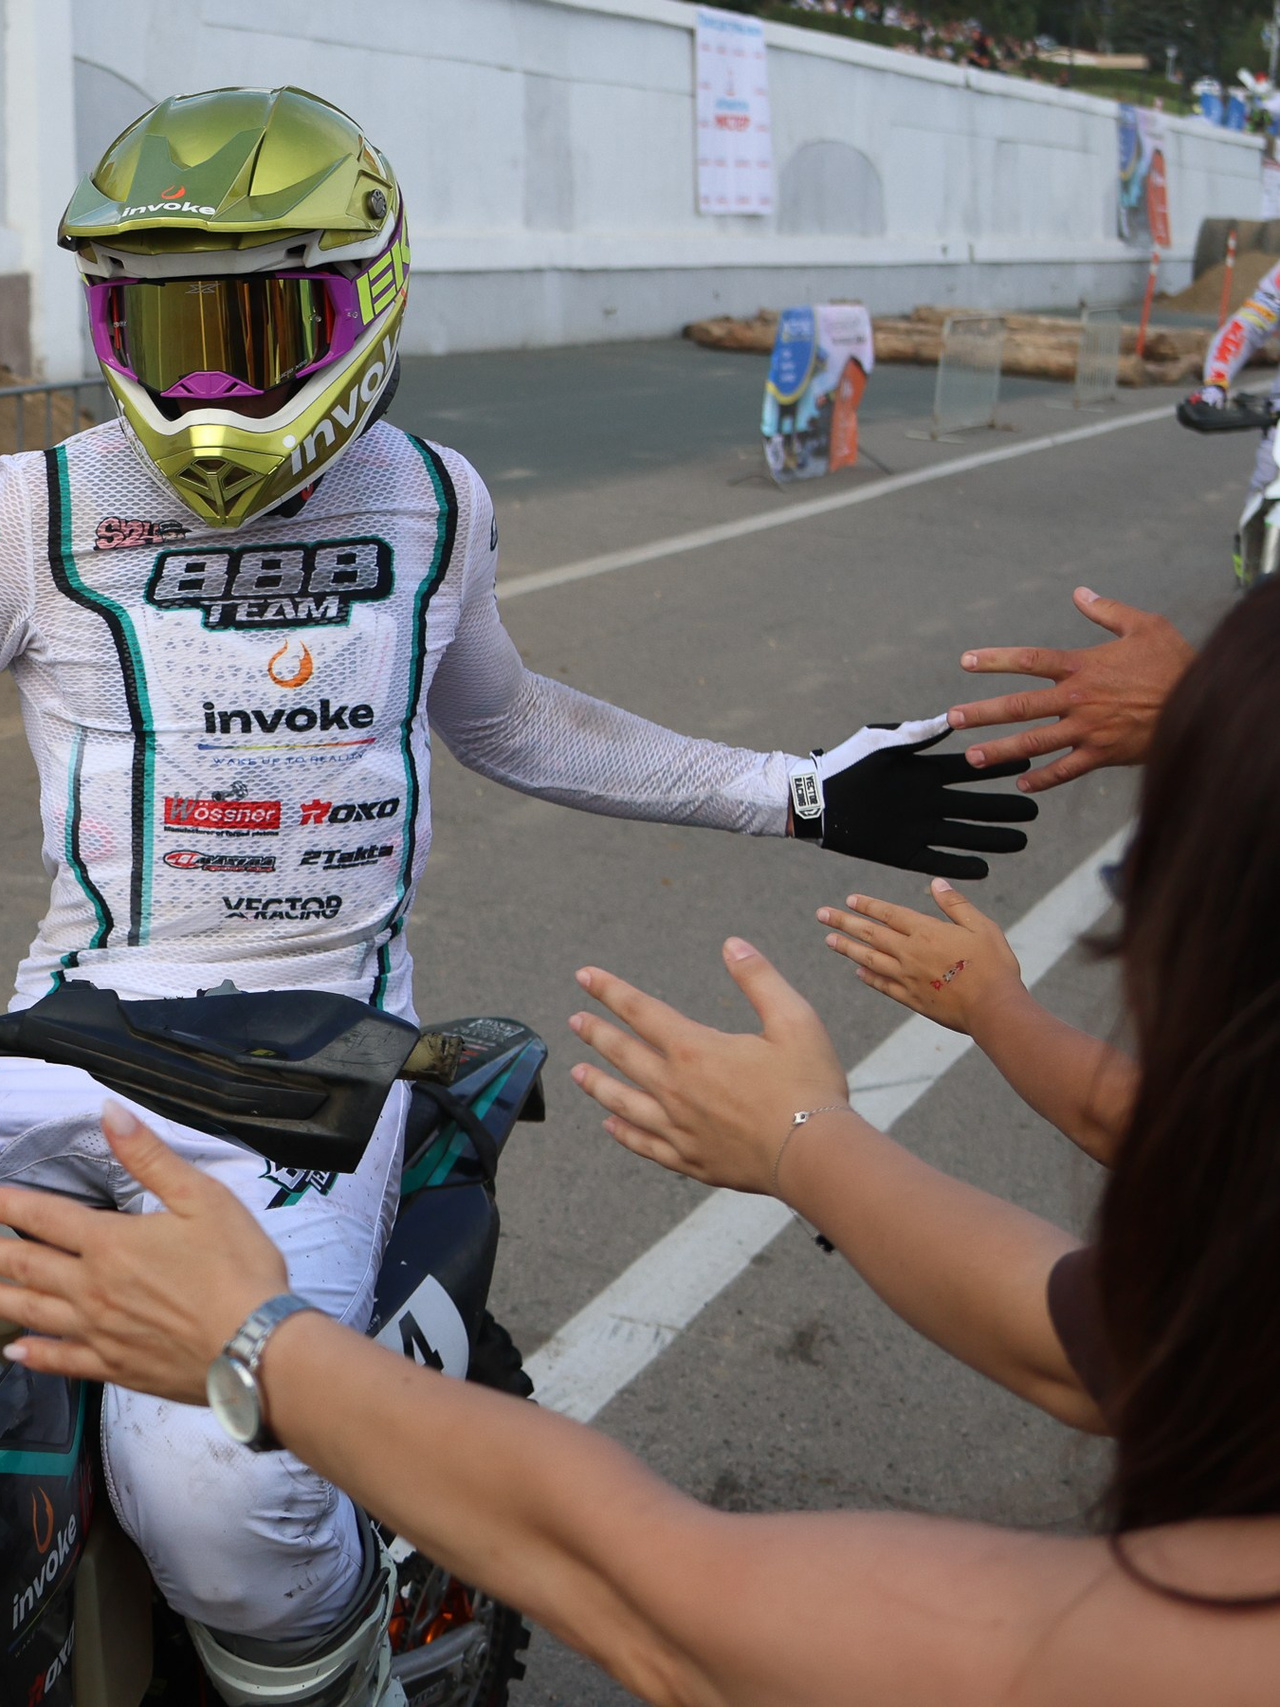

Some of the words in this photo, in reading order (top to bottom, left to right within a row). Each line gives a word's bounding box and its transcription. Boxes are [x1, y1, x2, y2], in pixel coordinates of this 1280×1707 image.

[121, 201, 216, 217] invoke
[153, 543, 380, 600] 888
[207, 596, 341, 623] TEAM
[202, 699, 375, 734] invoke
[213, 757, 256, 766] WAKE
[261, 757, 279, 765] UP
[286, 756, 307, 764] TO
[168, 791, 276, 823] Wössner
[299, 797, 401, 826] ROXO
[12, 1513, 77, 1631] invoke
